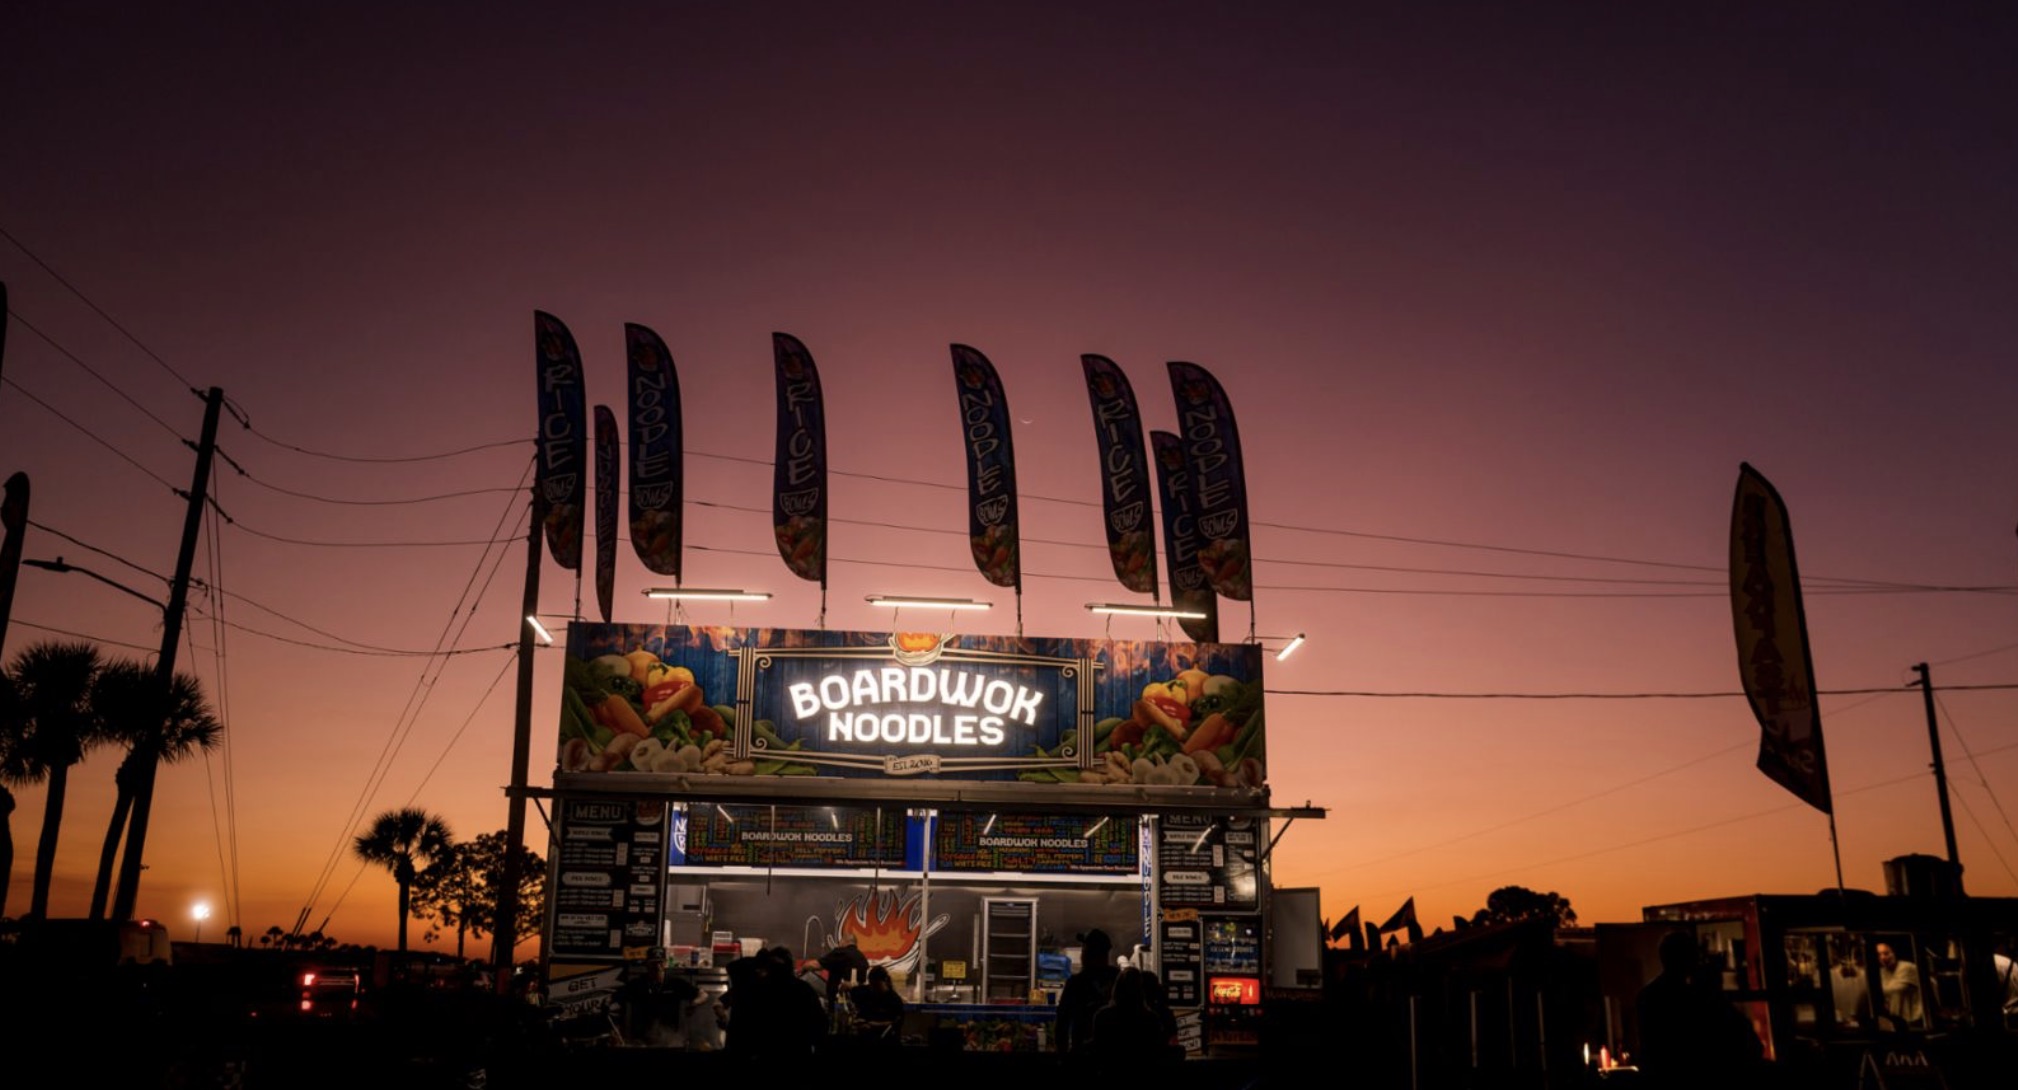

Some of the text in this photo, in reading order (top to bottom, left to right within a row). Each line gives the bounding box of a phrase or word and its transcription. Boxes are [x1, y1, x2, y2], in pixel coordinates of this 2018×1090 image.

[545, 364, 575, 469] RICE
[636, 372, 671, 478] NOODLE
[785, 381, 816, 485] RICE
[962, 389, 1003, 496] NOODLE
[1097, 399, 1137, 504] RICE
[1186, 405, 1231, 508] NOODLE
[1167, 471, 1198, 563] RICE
[789, 667, 1044, 726] BOARDWOK
[828, 712, 1004, 745] NOODLES
[575, 804, 621, 819] MENU
[804, 832, 853, 843] NOODLES
[979, 837, 1089, 849] BOARDWOK NOODLES
[1168, 814, 1212, 824] MENU
[568, 976, 598, 992] GET
